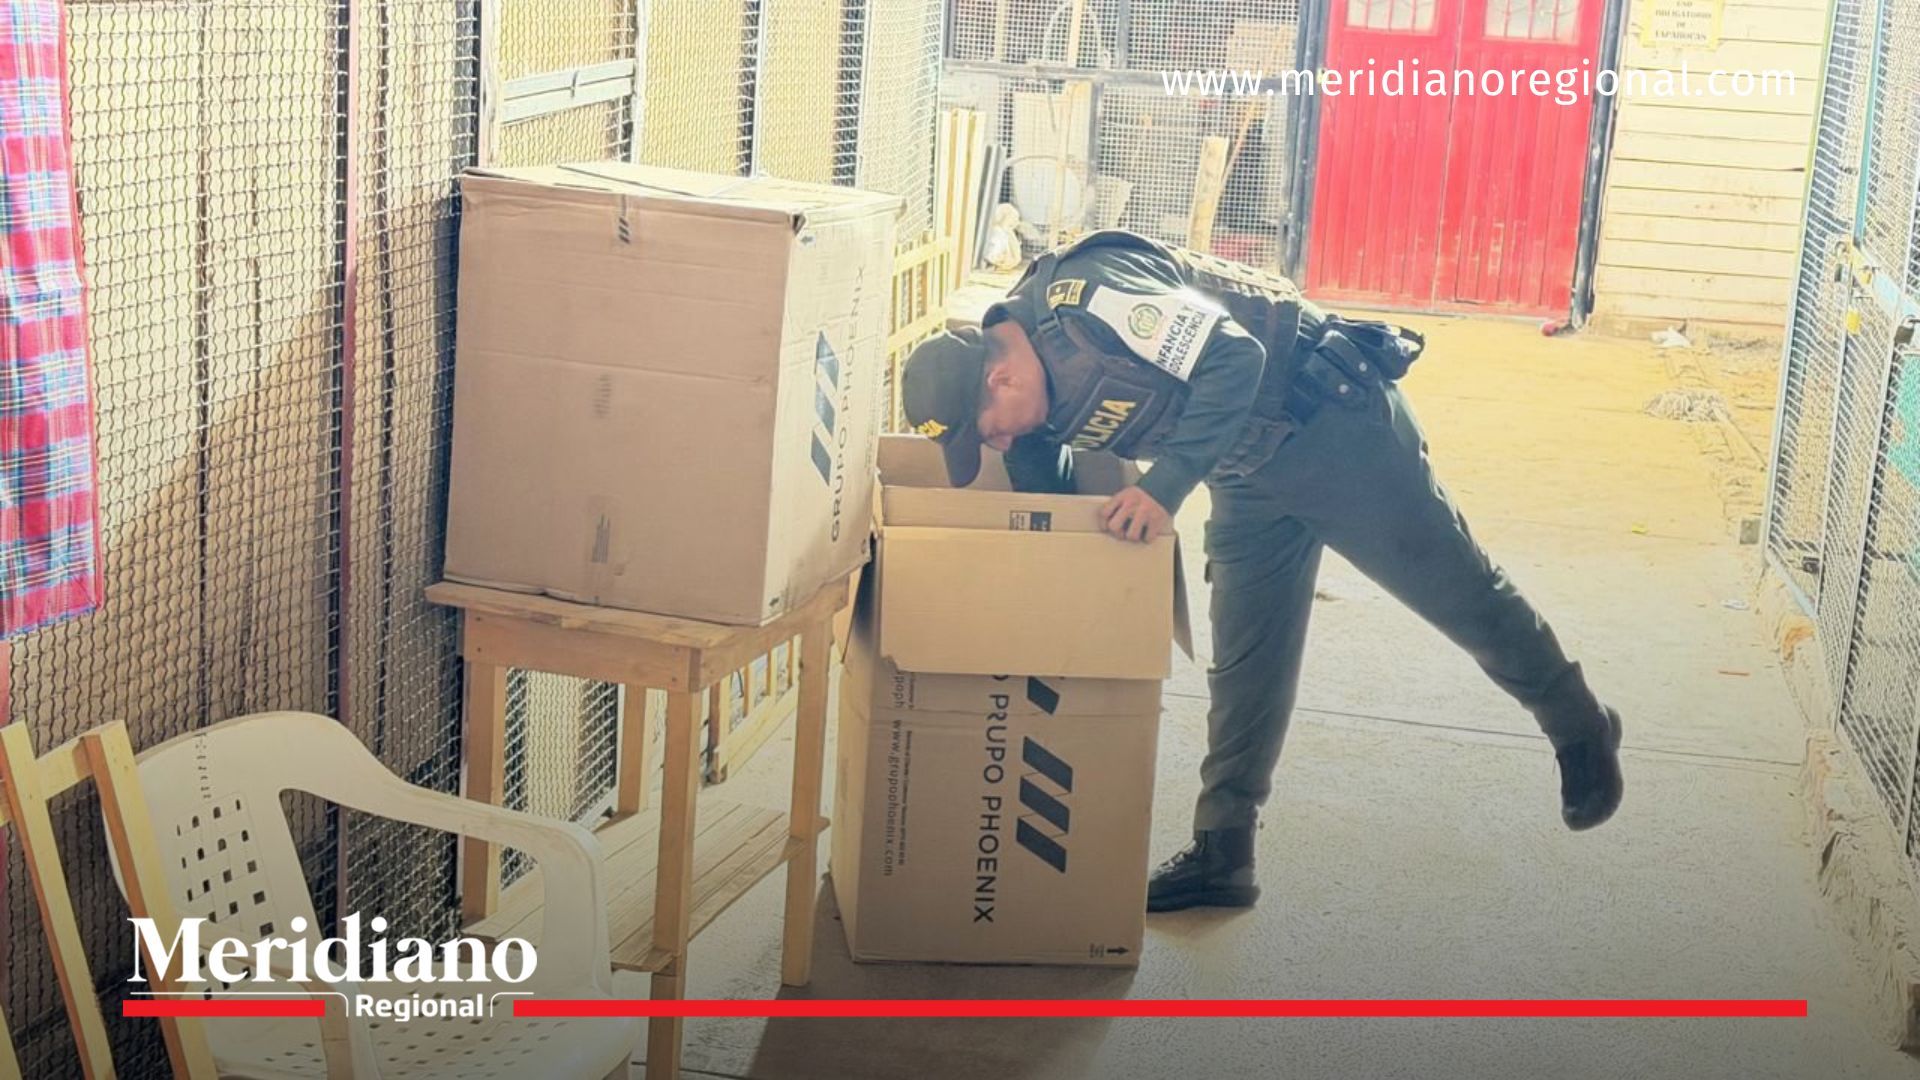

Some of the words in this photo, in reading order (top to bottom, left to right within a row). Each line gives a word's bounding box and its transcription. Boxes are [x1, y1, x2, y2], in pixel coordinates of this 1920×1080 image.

[830, 426, 847, 543] GRUPO
[840, 264, 865, 412] PHOENIX
[1156, 314, 1187, 367] NFANCIA
[884, 719, 903, 877] www.grupophoenix.com
[973, 795, 1002, 924] PHOENIX
